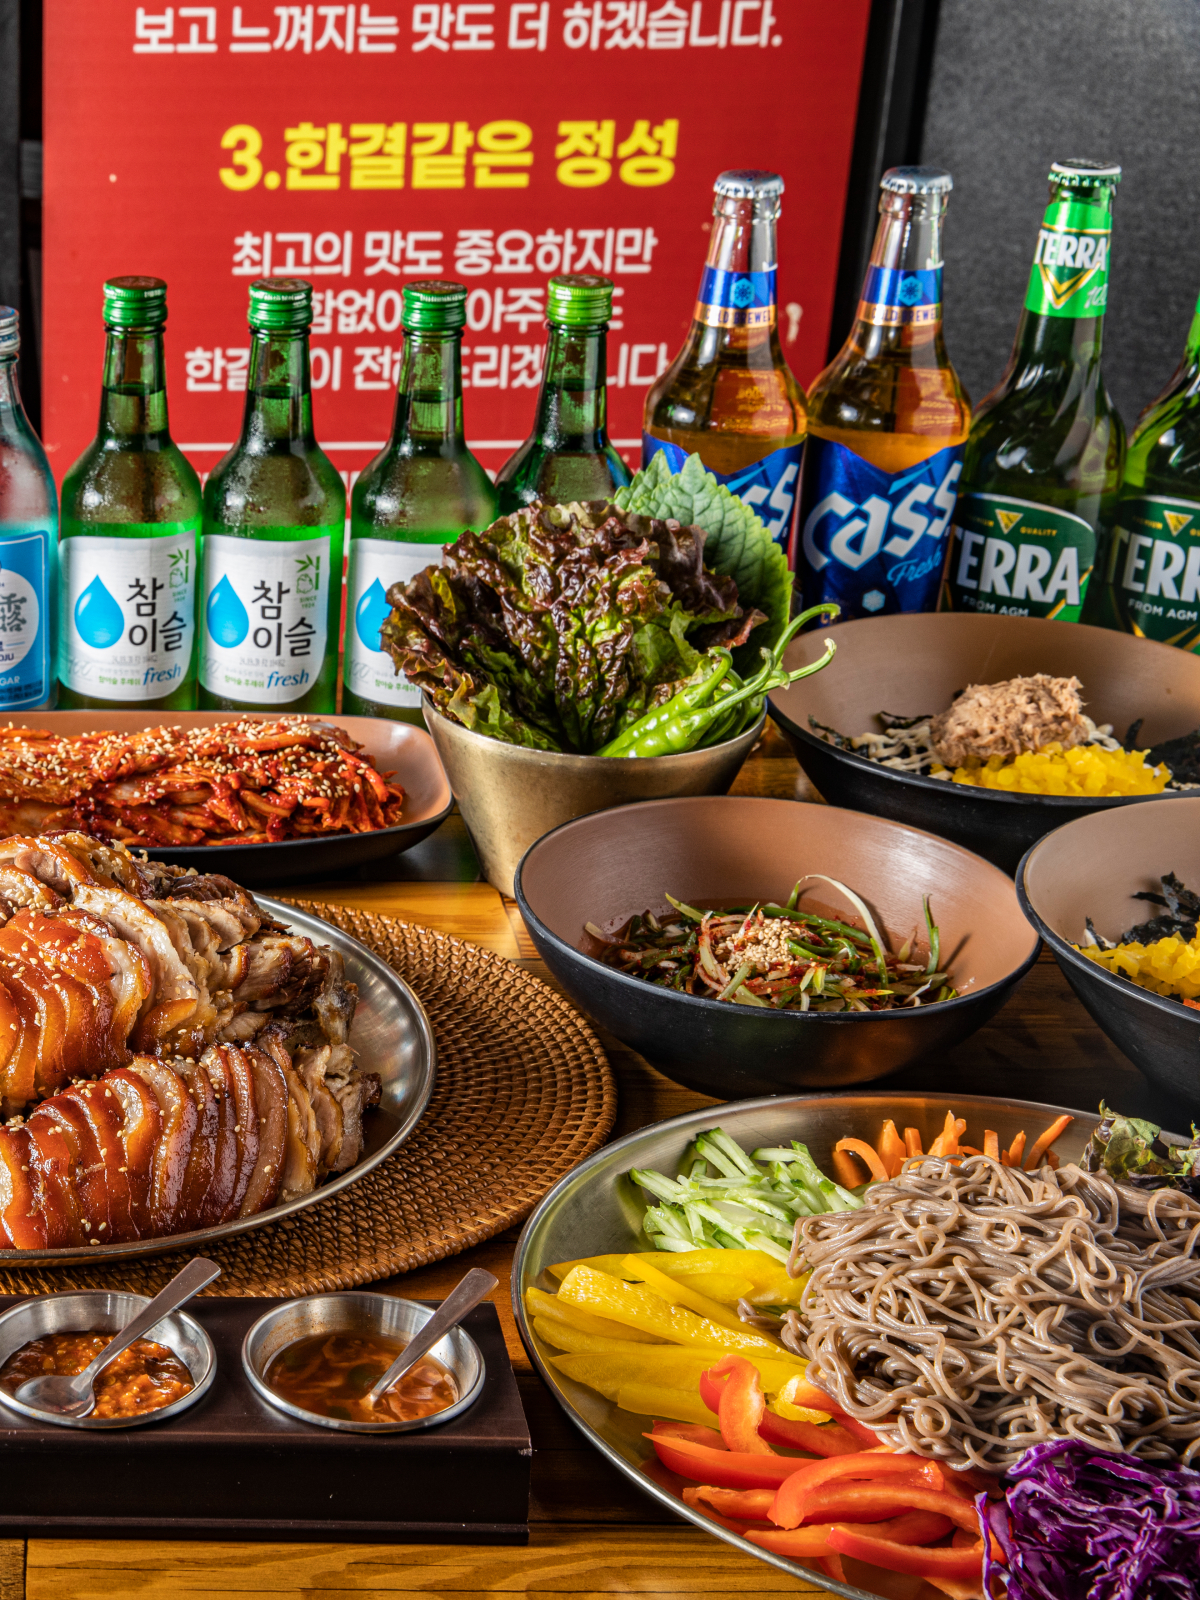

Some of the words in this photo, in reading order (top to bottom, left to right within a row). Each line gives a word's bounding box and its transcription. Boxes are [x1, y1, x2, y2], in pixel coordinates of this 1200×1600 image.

[132, 4, 218, 53] 보고
[228, 4, 399, 53] 느껴지는
[410, 2, 495, 51] 맛도
[507, 1, 549, 51] 더
[562, 0, 783, 50] 하겠습니다.
[218, 119, 535, 191] 3.한결같은
[554, 118, 680, 189] 정성
[231, 230, 353, 278] 최고의
[363, 230, 444, 277] 맛도
[453, 227, 659, 276] 중요하지만
[1034, 228, 1107, 272] TERRA
[705, 307, 730, 324] CLD
[871, 306, 898, 322] CLD
[962, 594, 996, 614] FROM
[1127, 597, 1164, 617] FROM
[1165, 609, 1198, 622] AGM
[142, 662, 182, 686] fresh
[266, 668, 310, 690] fresh
